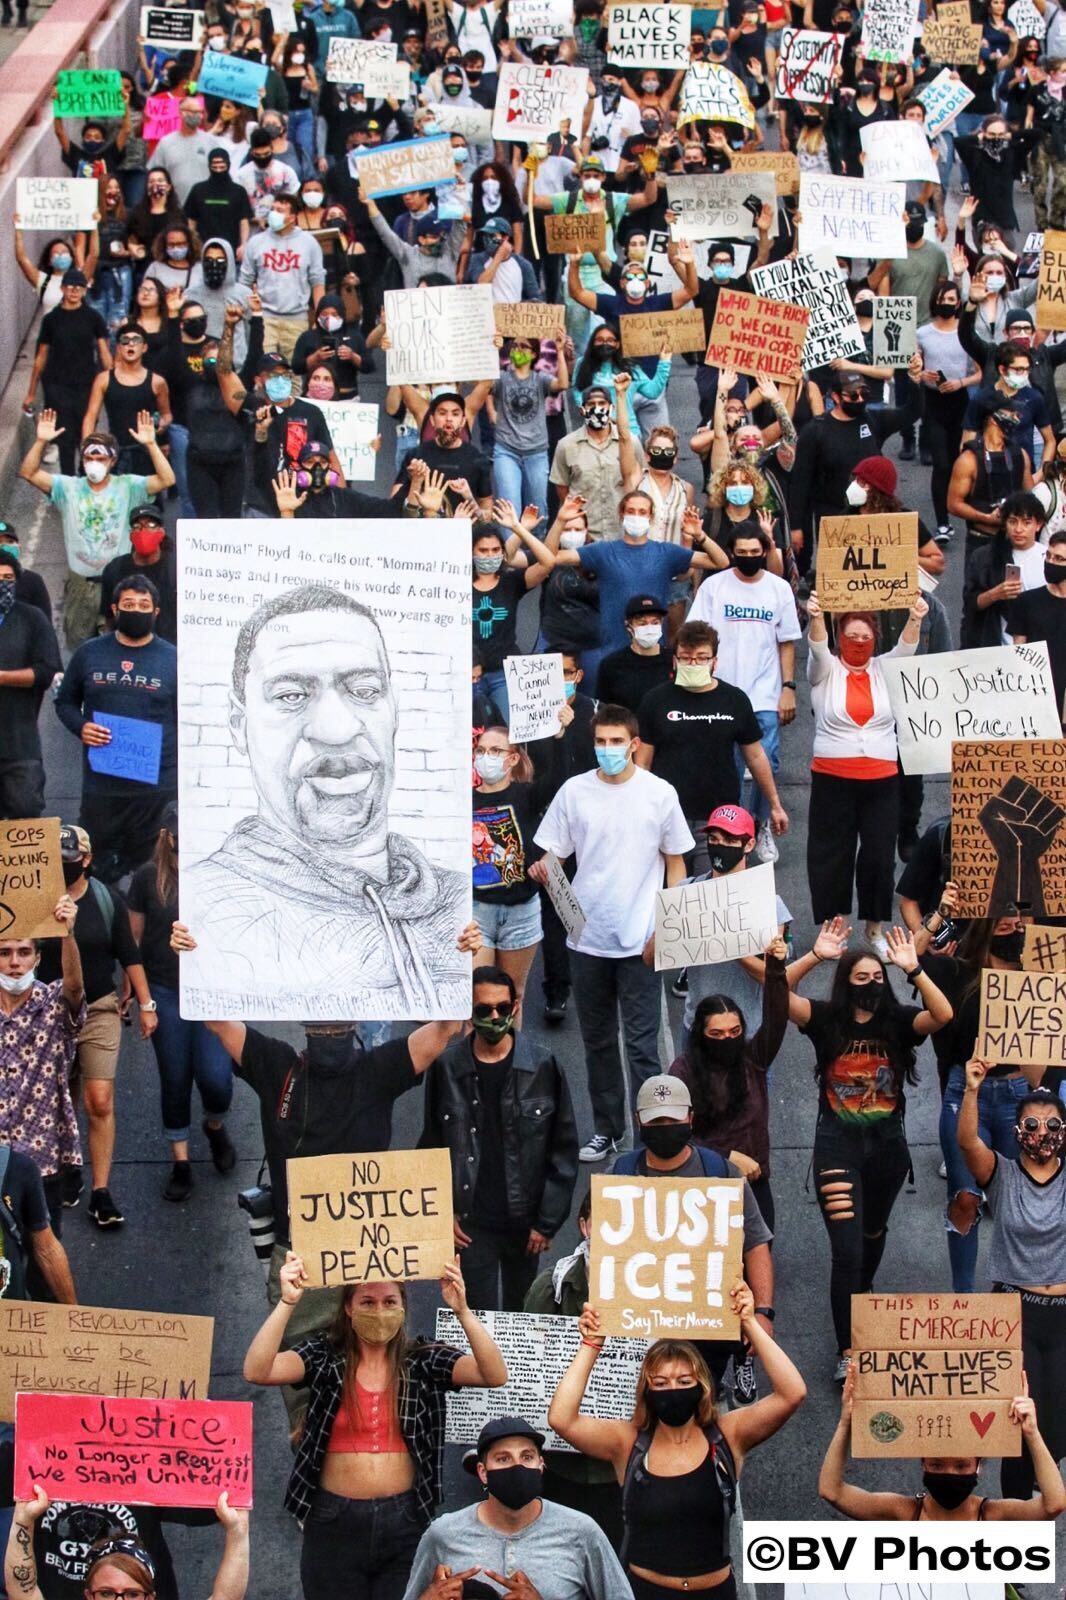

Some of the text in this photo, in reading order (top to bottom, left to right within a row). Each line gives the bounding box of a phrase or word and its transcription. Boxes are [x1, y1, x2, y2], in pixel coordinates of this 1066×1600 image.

[613, 7, 681, 24] BLACK
[620, 26, 677, 42] LIVES
[924, 22, 971, 37] SAYING
[927, 35, 978, 50] NOTHING
[67, 71, 73, 86] I
[516, 66, 562, 87] CLEAR
[57, 90, 125, 113] BREATHE
[508, 88, 567, 109] PRESENT
[685, 84, 740, 106] LIVES
[150, 104, 169, 115] WE
[506, 108, 552, 125] DANGER
[682, 100, 748, 118] MATTER
[927, 87, 970, 132] MURDER
[26, 180, 69, 196] BLACK
[33, 196, 72, 210] LIVES
[670, 198, 738, 212] GEORGE
[809, 182, 902, 217] SAY THEIR
[24, 211, 80, 228] MATTER!
[823, 214, 881, 244] NAME
[754, 253, 819, 290] IF YOU ARE
[819, 267, 839, 285] IN
[834, 281, 849, 303] OF
[385, 288, 443, 323] OPEN
[502, 303, 523, 313] END
[720, 292, 781, 318] WHO THE
[877, 298, 913, 308] BLACK
[839, 314, 857, 329] THE
[876, 309, 912, 321] LIVES
[387, 319, 439, 350] YOUR
[716, 312, 794, 340] DO WE CALL
[730, 329, 800, 358] WHEN COPS
[817, 332, 844, 351] THE
[708, 343, 729, 362] ARE
[733, 348, 754, 368] THE
[875, 353, 912, 366] MATTER
[357, 409, 377, 424] es
[821, 518, 856, 549] We
[319, 551, 347, 565] calls
[441, 560, 460, 575] I'm
[842, 545, 887, 571] ALL
[184, 564, 213, 578] man
[247, 570, 271, 584] and
[274, 572, 279, 584] I
[343, 578, 361, 592] his
[407, 584, 417, 598] A
[420, 585, 441, 600] call
[444, 587, 457, 600] to
[822, 572, 841, 591] be
[847, 571, 909, 601] outraged
[184, 589, 196, 601] to
[199, 588, 215, 602] be
[373, 607, 397, 618] two
[397, 611, 431, 624] years
[434, 615, 455, 628] ago
[724, 603, 774, 621] Bernie
[182, 613, 222, 626] sacred
[509, 658, 557, 677] A System
[92, 671, 162, 688] BEARS
[518, 673, 551, 692] Cannot
[528, 709, 552, 722] NEVER
[667, 710, 735, 723] Champion
[952, 743, 1022, 758] GEORGE
[952, 759, 1028, 773] WALTER
[952, 777, 1002, 789] ALTON
[6, 827, 46, 843] COPS
[952, 838, 992, 850] ERIC
[0, 869, 41, 896] YOU!
[552, 862, 579, 914] Silence
[657, 877, 747, 916] WHITE
[663, 901, 751, 943] SILENCE
[659, 950, 676, 968] IS
[986, 973, 1066, 1003] BLACK
[985, 1004, 1063, 1032] LIVES
[352, 1160, 380, 1187] NO
[300, 1187, 438, 1222] JUSTICE
[360, 1222, 390, 1249] NO
[321, 1245, 420, 1286] PEACE
[599, 1250, 725, 1308] ICE!
[869, 1298, 913, 1311] THIS
[928, 1298, 939, 1311] IS
[1022, 1293, 1050, 1306] NIKE
[6, 1308, 48, 1328] THE
[621, 1308, 724, 1335] Say Their Names
[900, 1316, 1020, 1343] EMERGENCY
[1, 1339, 145, 1360] will not be
[620, 1352, 645, 1362] FLOYD
[859, 1350, 1012, 1374] BLACK LIVES
[11, 1367, 100, 1393] televised
[892, 1371, 1000, 1397] MATTER
[81, 1400, 237, 1446] Justice,
[46, 1445, 251, 1476] No Longer a Request
[29, 1465, 249, 1491] We Stand United!!!
[45, 1552, 70, 1571] BEV
